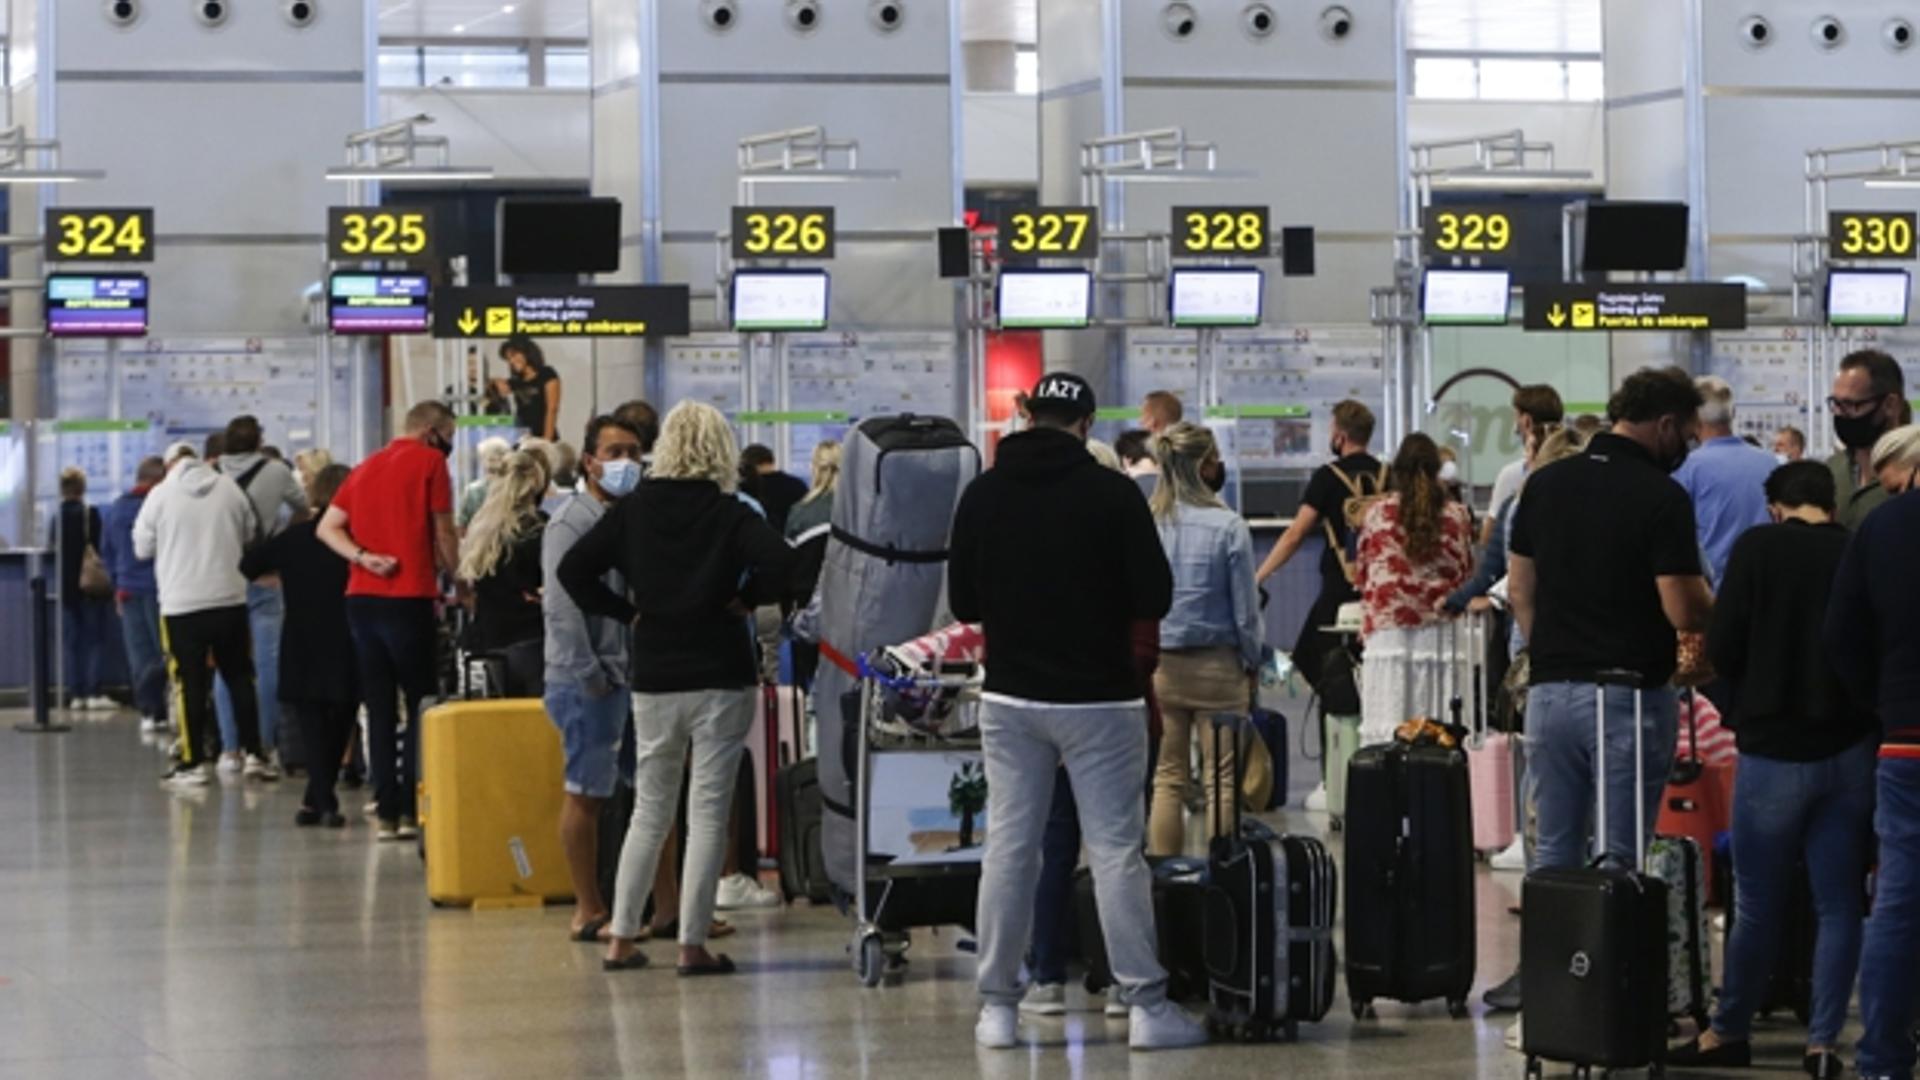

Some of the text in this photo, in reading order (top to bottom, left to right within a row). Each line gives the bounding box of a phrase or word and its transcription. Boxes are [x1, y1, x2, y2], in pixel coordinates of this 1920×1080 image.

[57, 214, 145, 255] 324
[341, 213, 426, 254] 325
[745, 213, 827, 253] 326
[1011, 213, 1089, 252] 327
[1185, 212, 1263, 251] 328
[1436, 213, 1511, 251] 329
[1842, 216, 1912, 254] 330
[516, 320, 645, 334] Puertas de embarque
